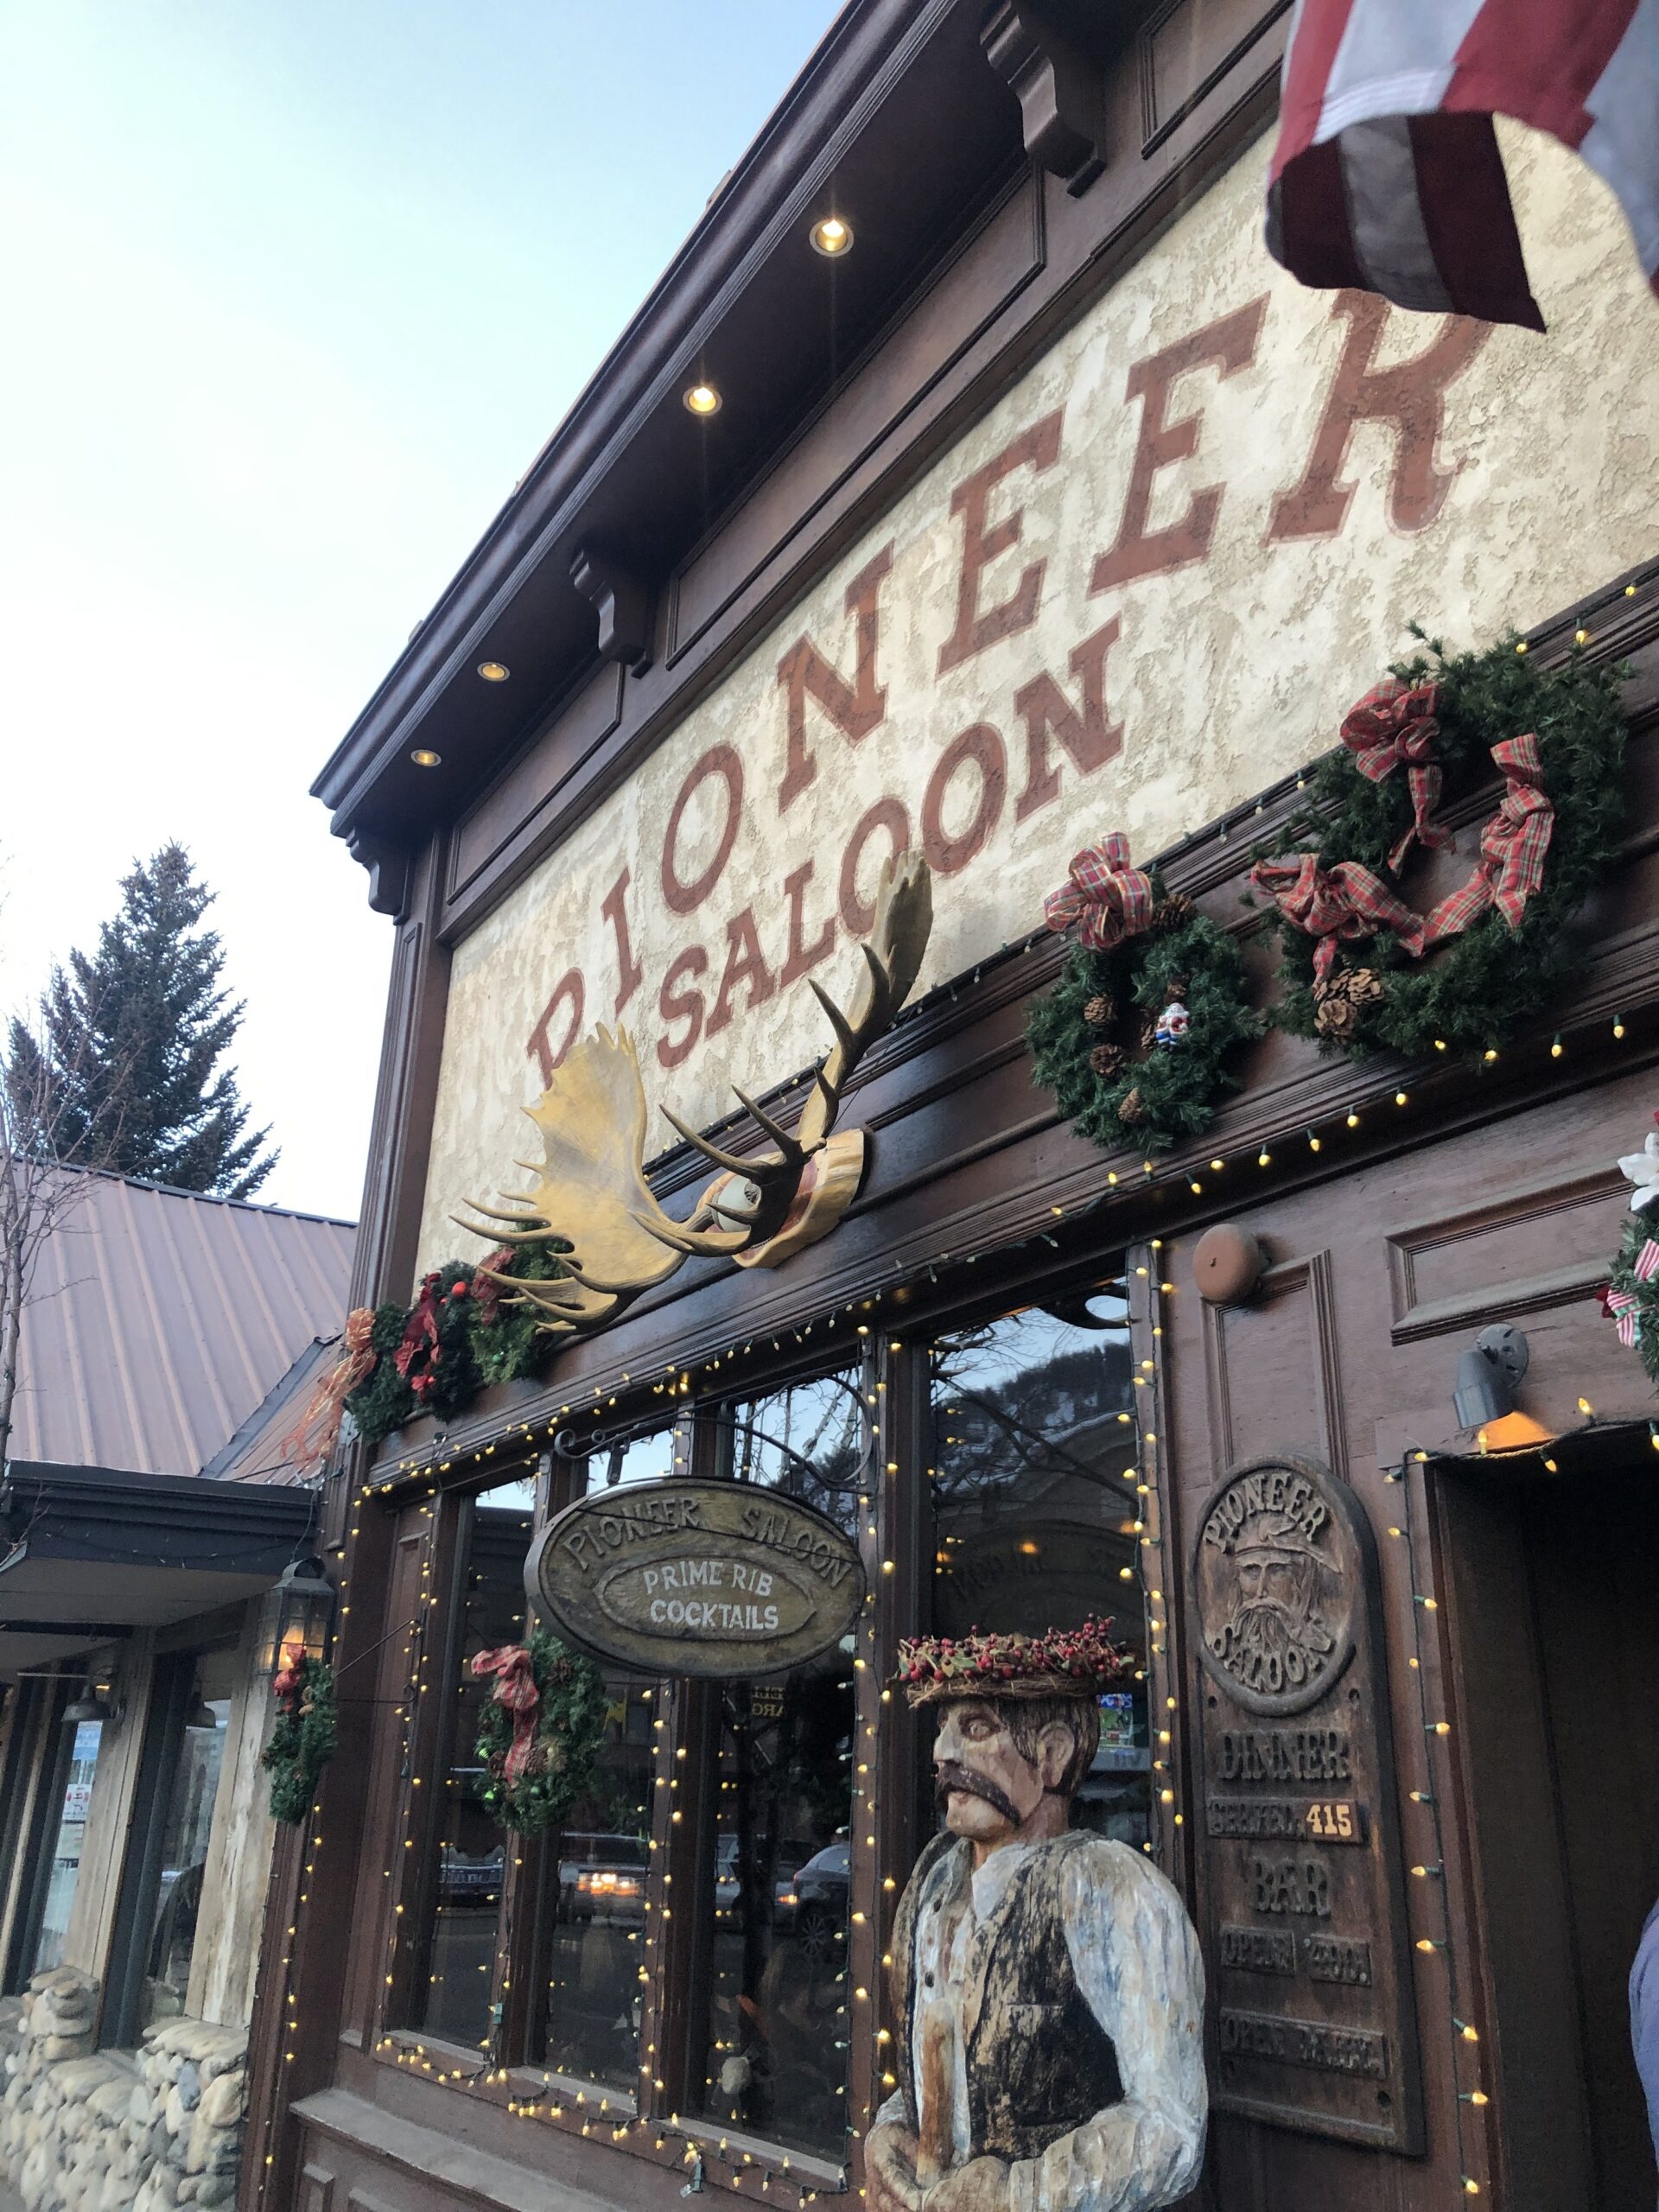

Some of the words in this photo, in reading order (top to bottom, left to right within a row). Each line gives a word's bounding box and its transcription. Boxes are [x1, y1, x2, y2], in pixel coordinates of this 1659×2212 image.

[525, 288, 1496, 1090] PIONEER
[657, 613, 1126, 1071] SALOON
[563, 1497, 702, 1571] PIONEER
[741, 1508, 852, 1588] SALOON
[1204, 1473, 1328, 1554] PIONEER
[644, 1560, 723, 1595] PRIME
[731, 1565, 774, 1598] RIB
[650, 1599, 779, 1630] COCKTAILS
[1211, 1623, 1335, 1692] SALOON
[1217, 1730, 1351, 1779] DINNER
[1306, 1804, 1352, 1836] 415
[1250, 1857, 1332, 1916] BAR
